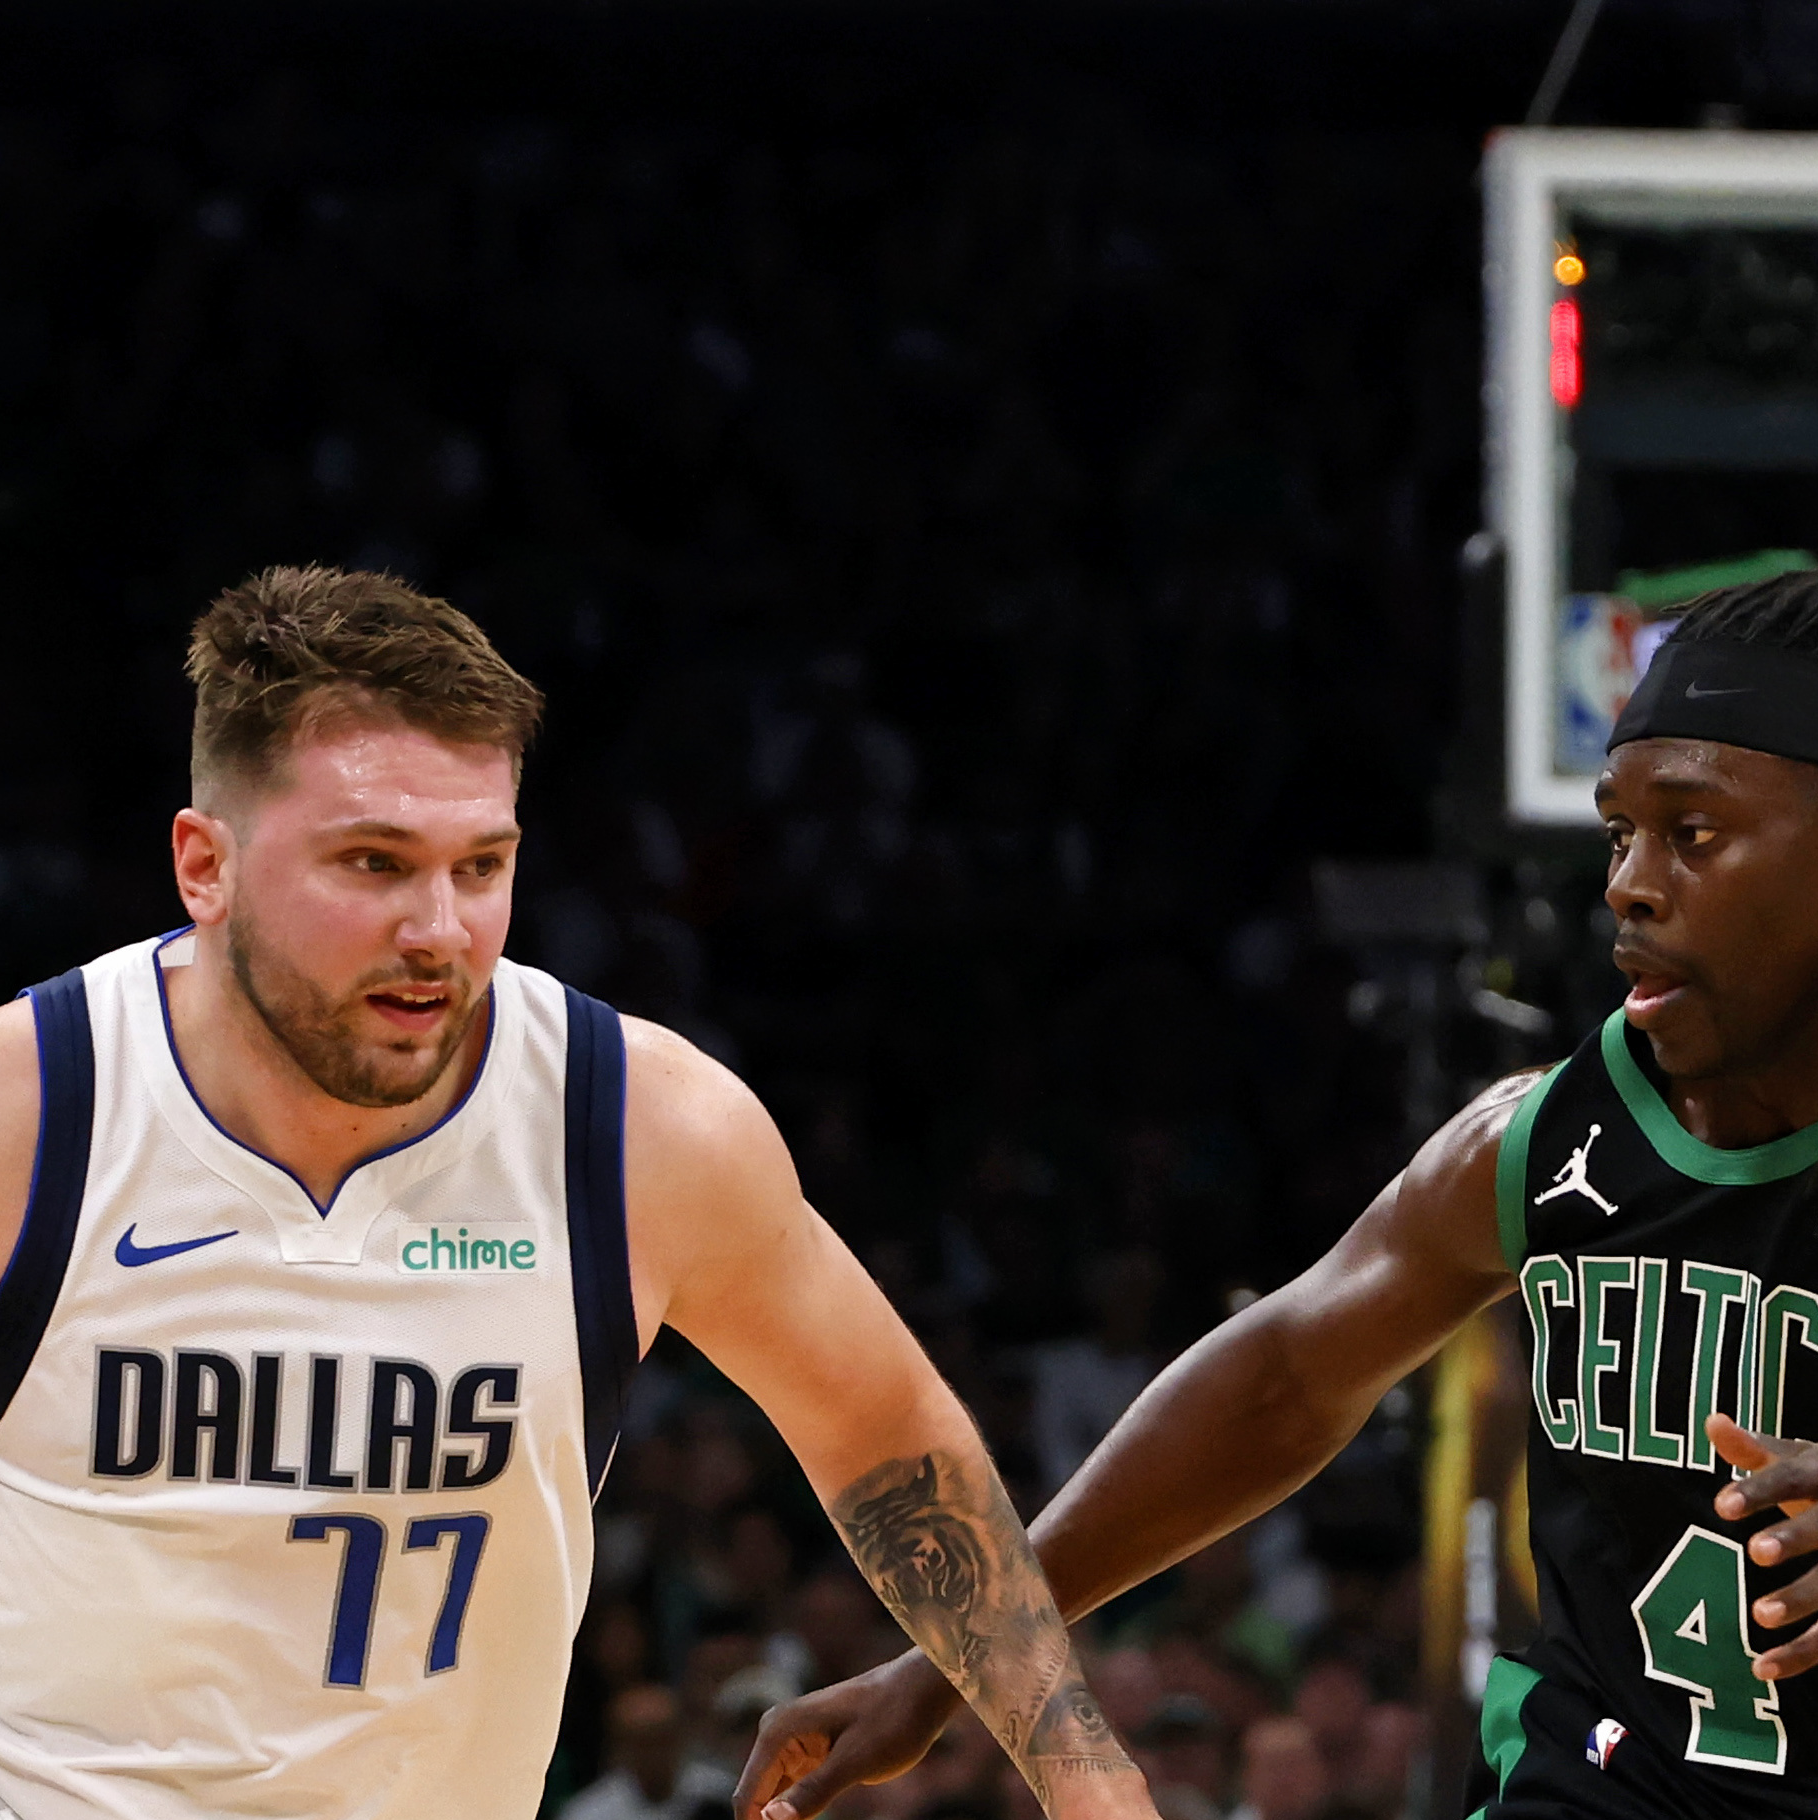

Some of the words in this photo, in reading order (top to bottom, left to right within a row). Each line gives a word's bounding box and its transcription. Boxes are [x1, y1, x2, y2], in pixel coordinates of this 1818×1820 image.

[402, 1227, 536, 1270] chime
[89, 1344, 523, 1494] DALLAS
[285, 1511, 493, 1691] 77
[1631, 1524, 1787, 1776] 4
